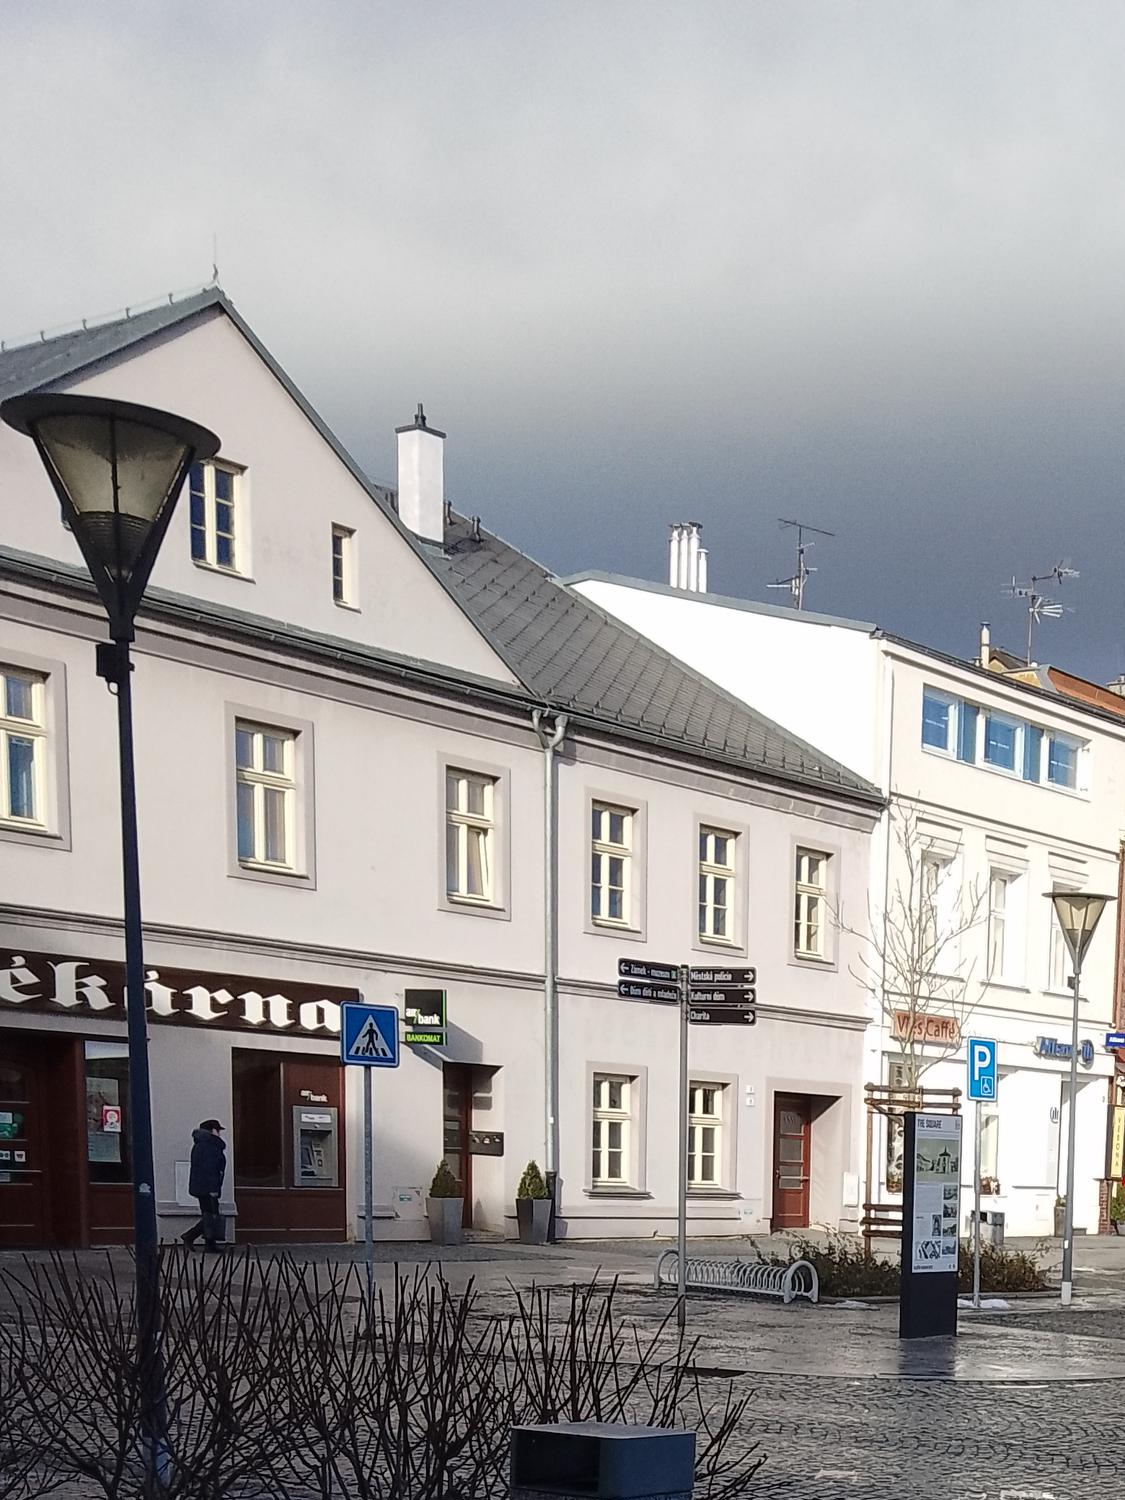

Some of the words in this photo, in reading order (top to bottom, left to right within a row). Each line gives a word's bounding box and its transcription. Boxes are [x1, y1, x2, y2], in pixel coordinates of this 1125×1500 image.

[418, 1014, 440, 1025] bank
[406, 1033, 441, 1043] BANKOMAT
[974, 1045, 991, 1081] P
